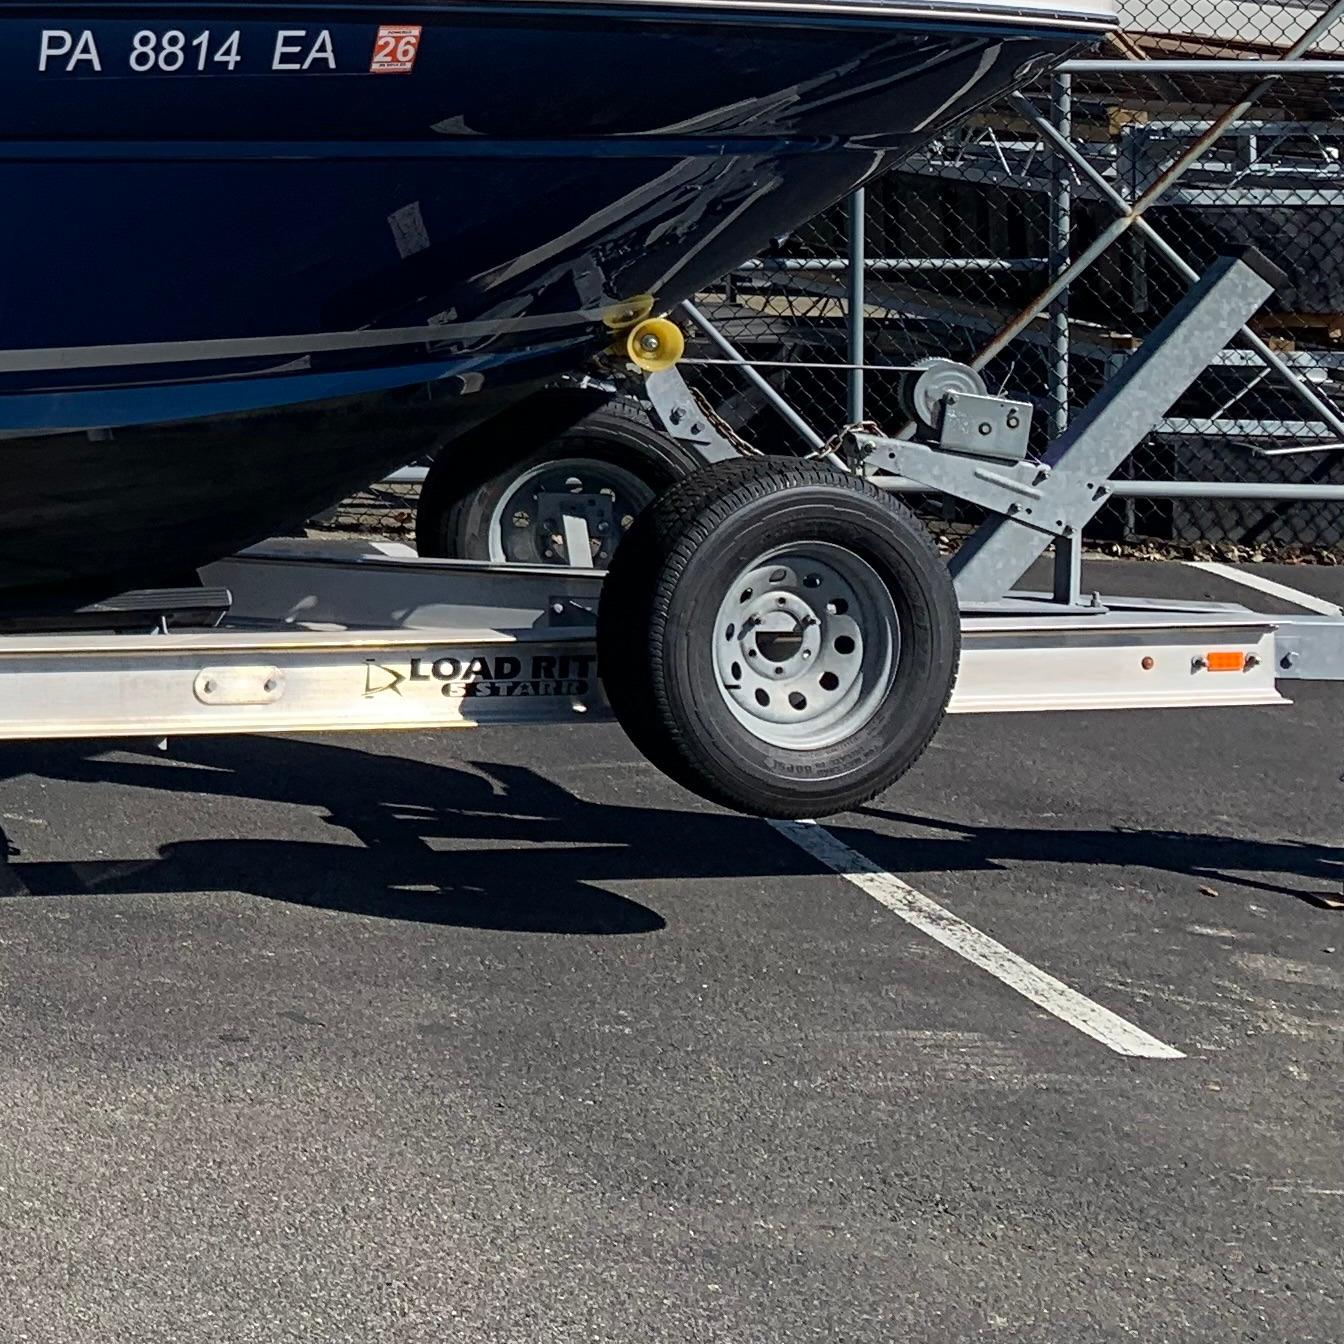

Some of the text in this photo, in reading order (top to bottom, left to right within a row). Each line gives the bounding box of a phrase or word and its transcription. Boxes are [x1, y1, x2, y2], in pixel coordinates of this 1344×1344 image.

[38, 30, 337, 72] PA 8814 EA
[373, 36, 417, 62] 26
[410, 656, 597, 681] LOAD RIT
